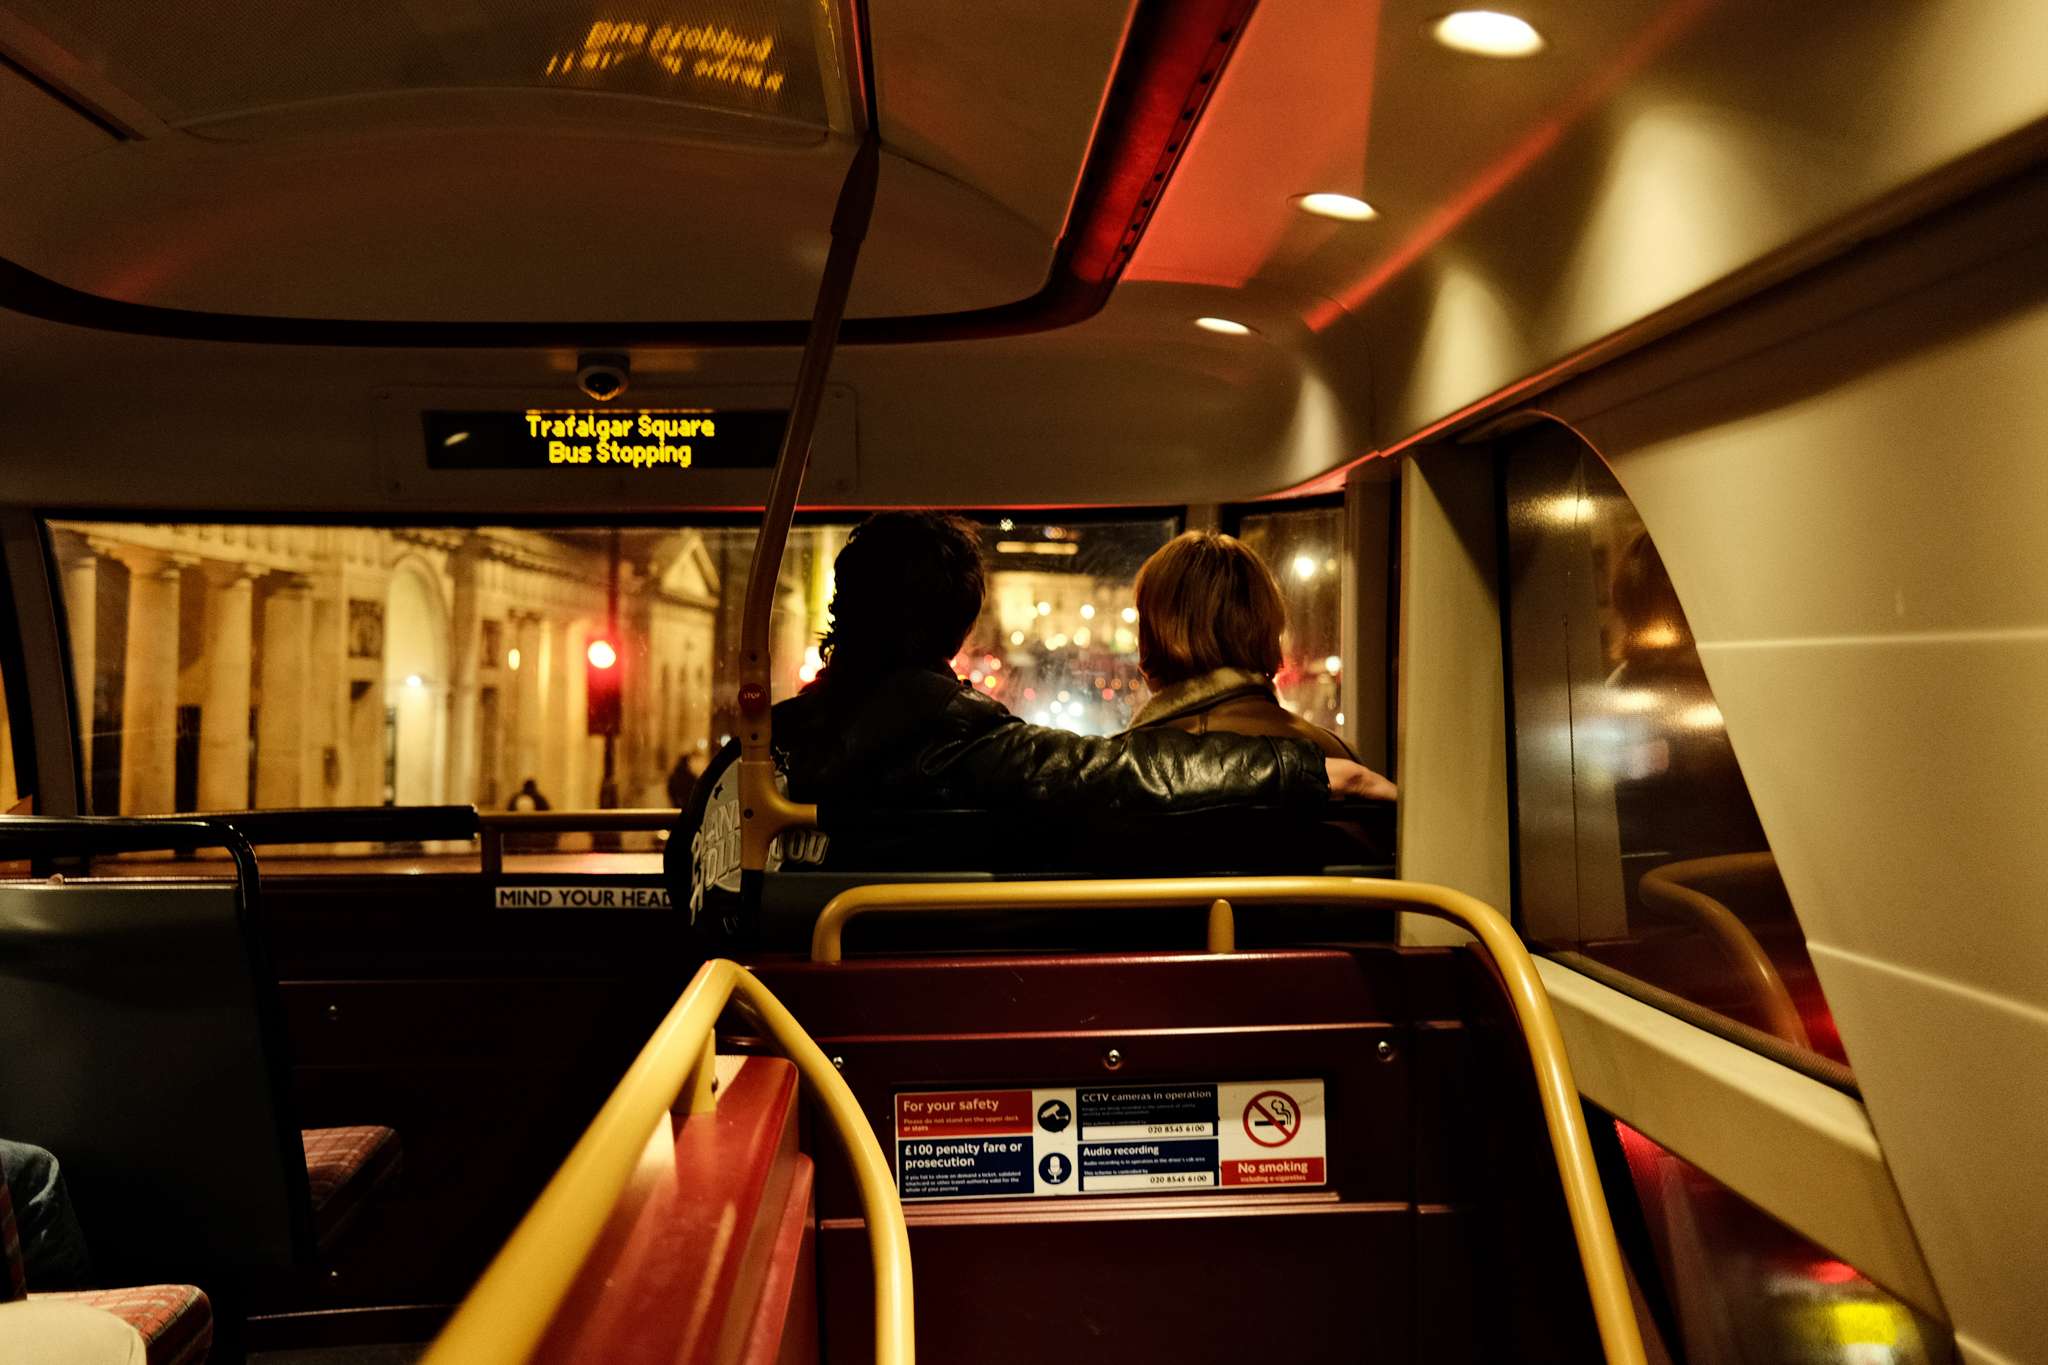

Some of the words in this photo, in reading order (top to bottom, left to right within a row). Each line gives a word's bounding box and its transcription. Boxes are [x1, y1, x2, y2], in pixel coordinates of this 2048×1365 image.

[525, 415, 634, 442] Trafalgar
[638, 415, 715, 442] Square
[549, 441, 592, 463] Bus
[596, 441, 691, 468] Stopping
[500, 891, 552, 905] MIND
[559, 890, 615, 906] YOUR
[622, 891, 672, 906] HEAD
[1082, 1094, 1109, 1102] CCTV
[1154, 1092, 1162, 1100] in
[1165, 1090, 1211, 1100] operation
[903, 1100, 923, 1112] For
[927, 1101, 956, 1113] your
[959, 1099, 999, 1112] safety
[1148, 1126, 1162, 1134] 020
[1165, 1125, 1183, 1133] 8545
[1186, 1124, 1205, 1132] 6100
[905, 1145, 933, 1156] £100
[936, 1143, 980, 1157] penalty
[983, 1142, 1006, 1153] fare
[1010, 1143, 1022, 1151] or
[1083, 1147, 1111, 1156] Audio
[1114, 1145, 1159, 1156] recording
[905, 1157, 974, 1170] prosecution
[1238, 1163, 1255, 1174] No
[1259, 1161, 1308, 1174] smoking
